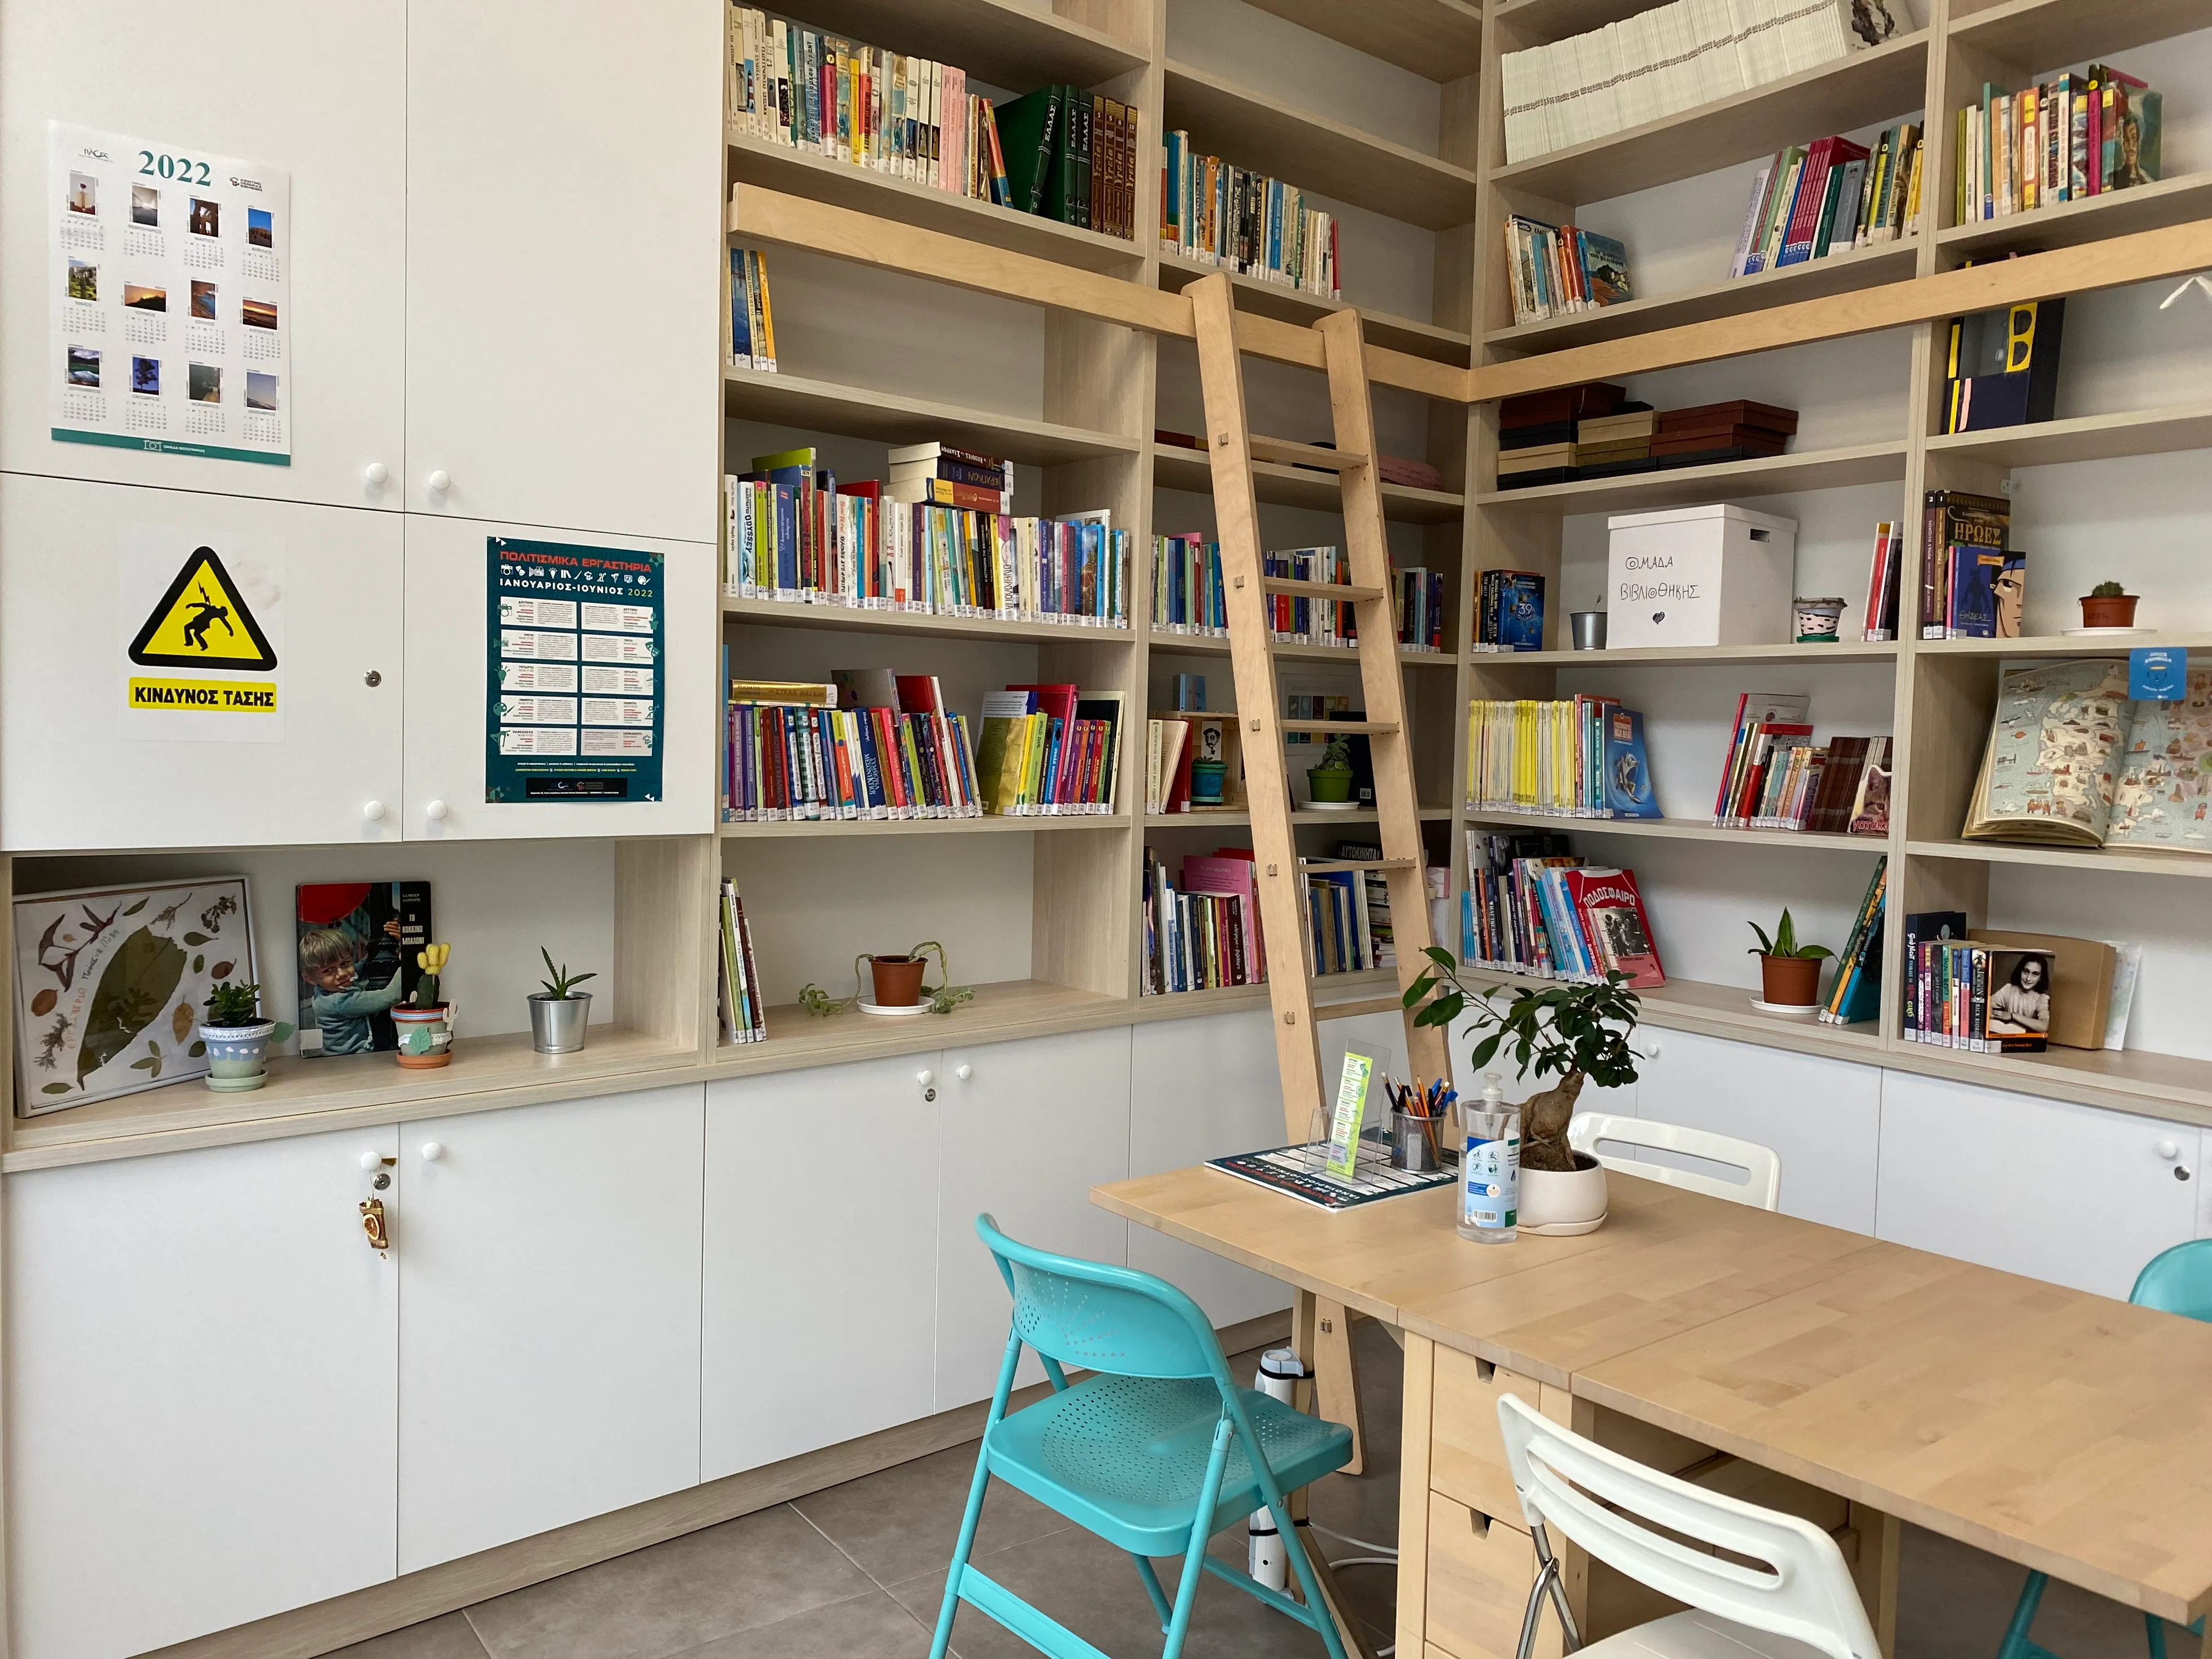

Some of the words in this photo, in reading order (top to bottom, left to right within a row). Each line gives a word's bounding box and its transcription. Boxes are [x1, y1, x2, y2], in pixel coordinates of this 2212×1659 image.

[139, 150, 211, 187] 2022
[744, 515, 753, 554] ODYSSEY
[1955, 522, 2001, 545] ΗΡΩΕΣ
[500, 551, 578, 566] ΠΟΛΙΤΙΣΜΙΚΑ
[582, 558, 652, 573] ΕΡΓΑΣΤΗΡΙΑ
[1625, 556, 1673, 571] ΟΜΑΔΑ
[500, 578, 623, 595] ΙΑΝΟΥΑΡΙΟΣ-ΙΟΥΝΙΟΣ
[628, 588, 653, 597] 2022
[1003, 564, 1013, 610] ΟΝΕΙΡΟΛΟΓΙΑ
[1620, 583, 1700, 601] ΒΙΒΛΙΟΘΗΚΗΣ
[1518, 603, 1533, 615] 39
[135, 687, 218, 705] ΚΙΝΔΥΝΟΣ
[223, 690, 274, 707] ΤΑΣΗΣ
[1583, 887, 1635, 909] ΠΟΔΟΣΦΑΙΡΟ
[402, 937, 425, 945] ΜΠΑΛΟΝΙ
[1976, 968, 1984, 996] JACKSON
[1906, 1001, 1915, 1018] GIRLS
